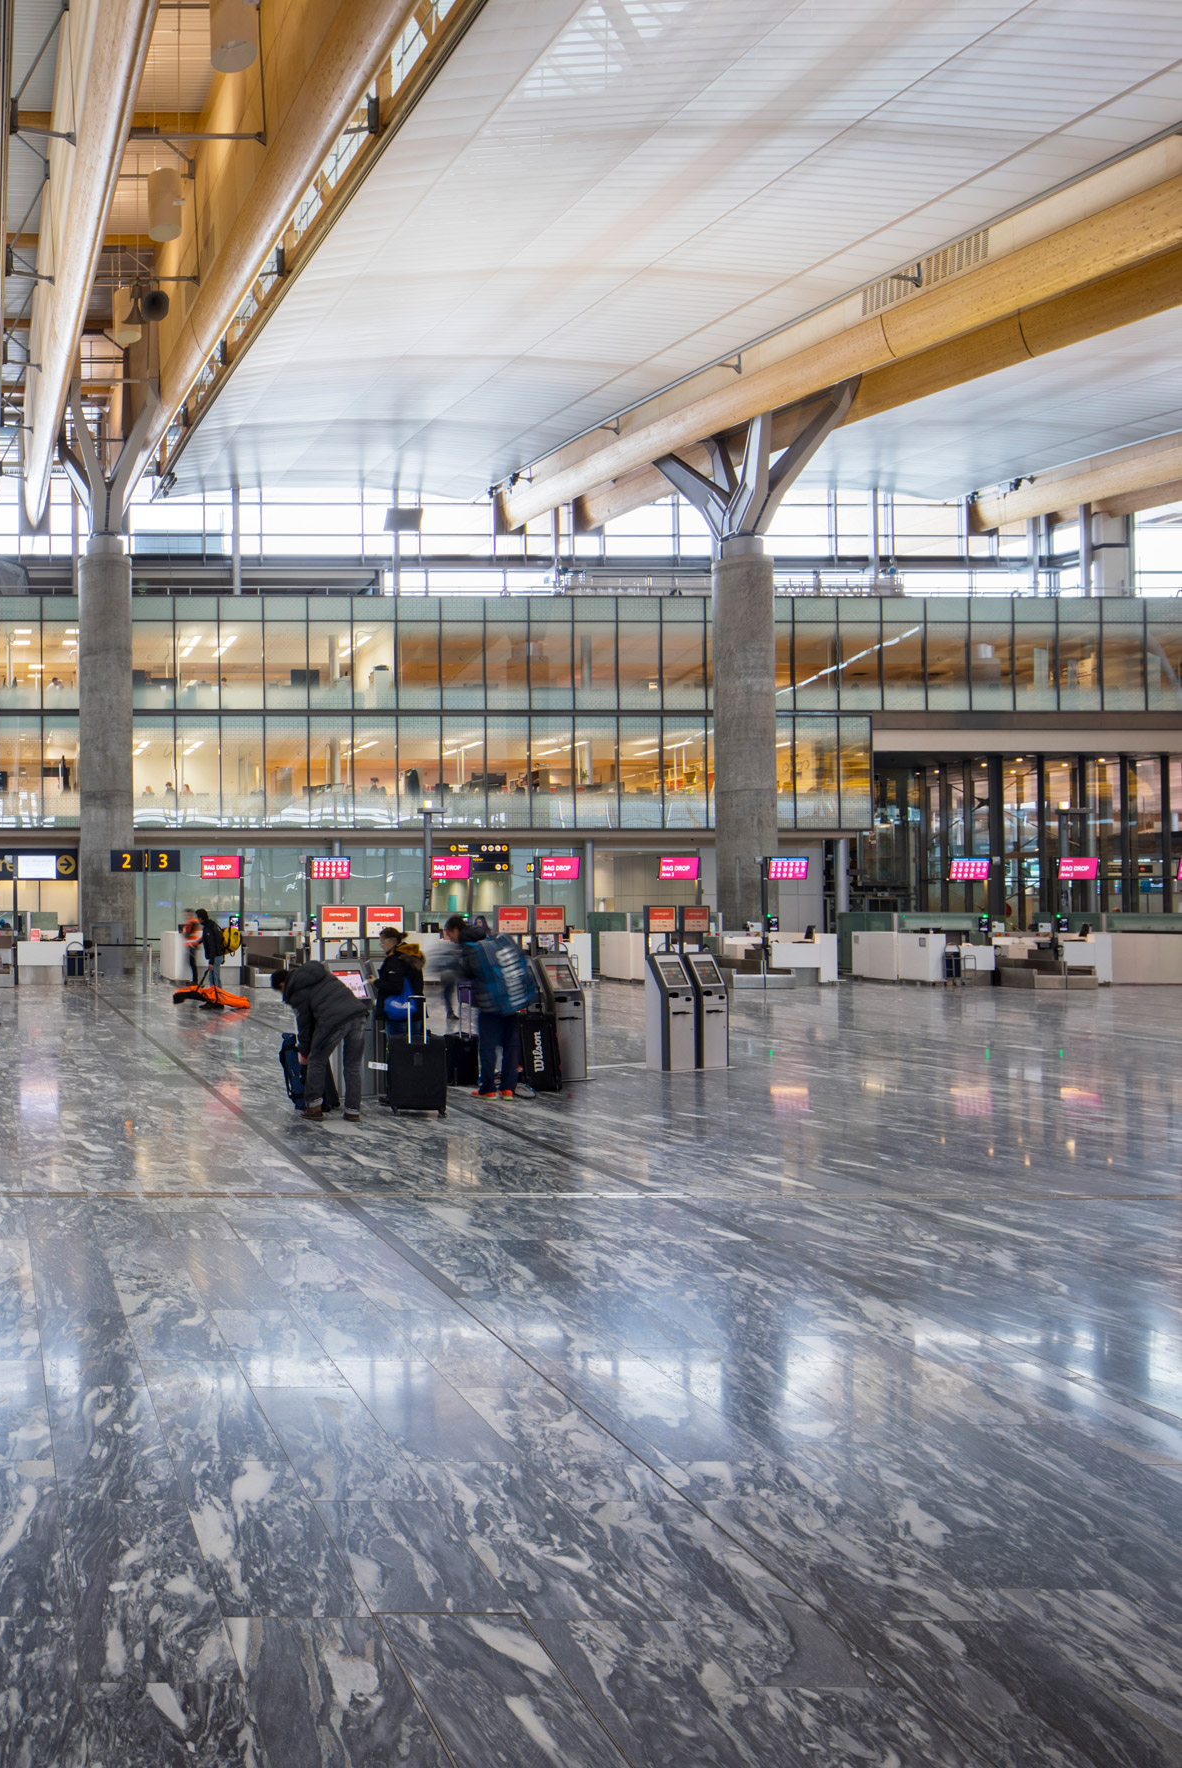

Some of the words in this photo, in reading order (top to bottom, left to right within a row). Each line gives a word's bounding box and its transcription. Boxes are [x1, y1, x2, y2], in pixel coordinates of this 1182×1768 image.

[121, 853, 131, 868] 2
[158, 853, 168, 868] 3
[532, 1030, 545, 1073] Wilson
